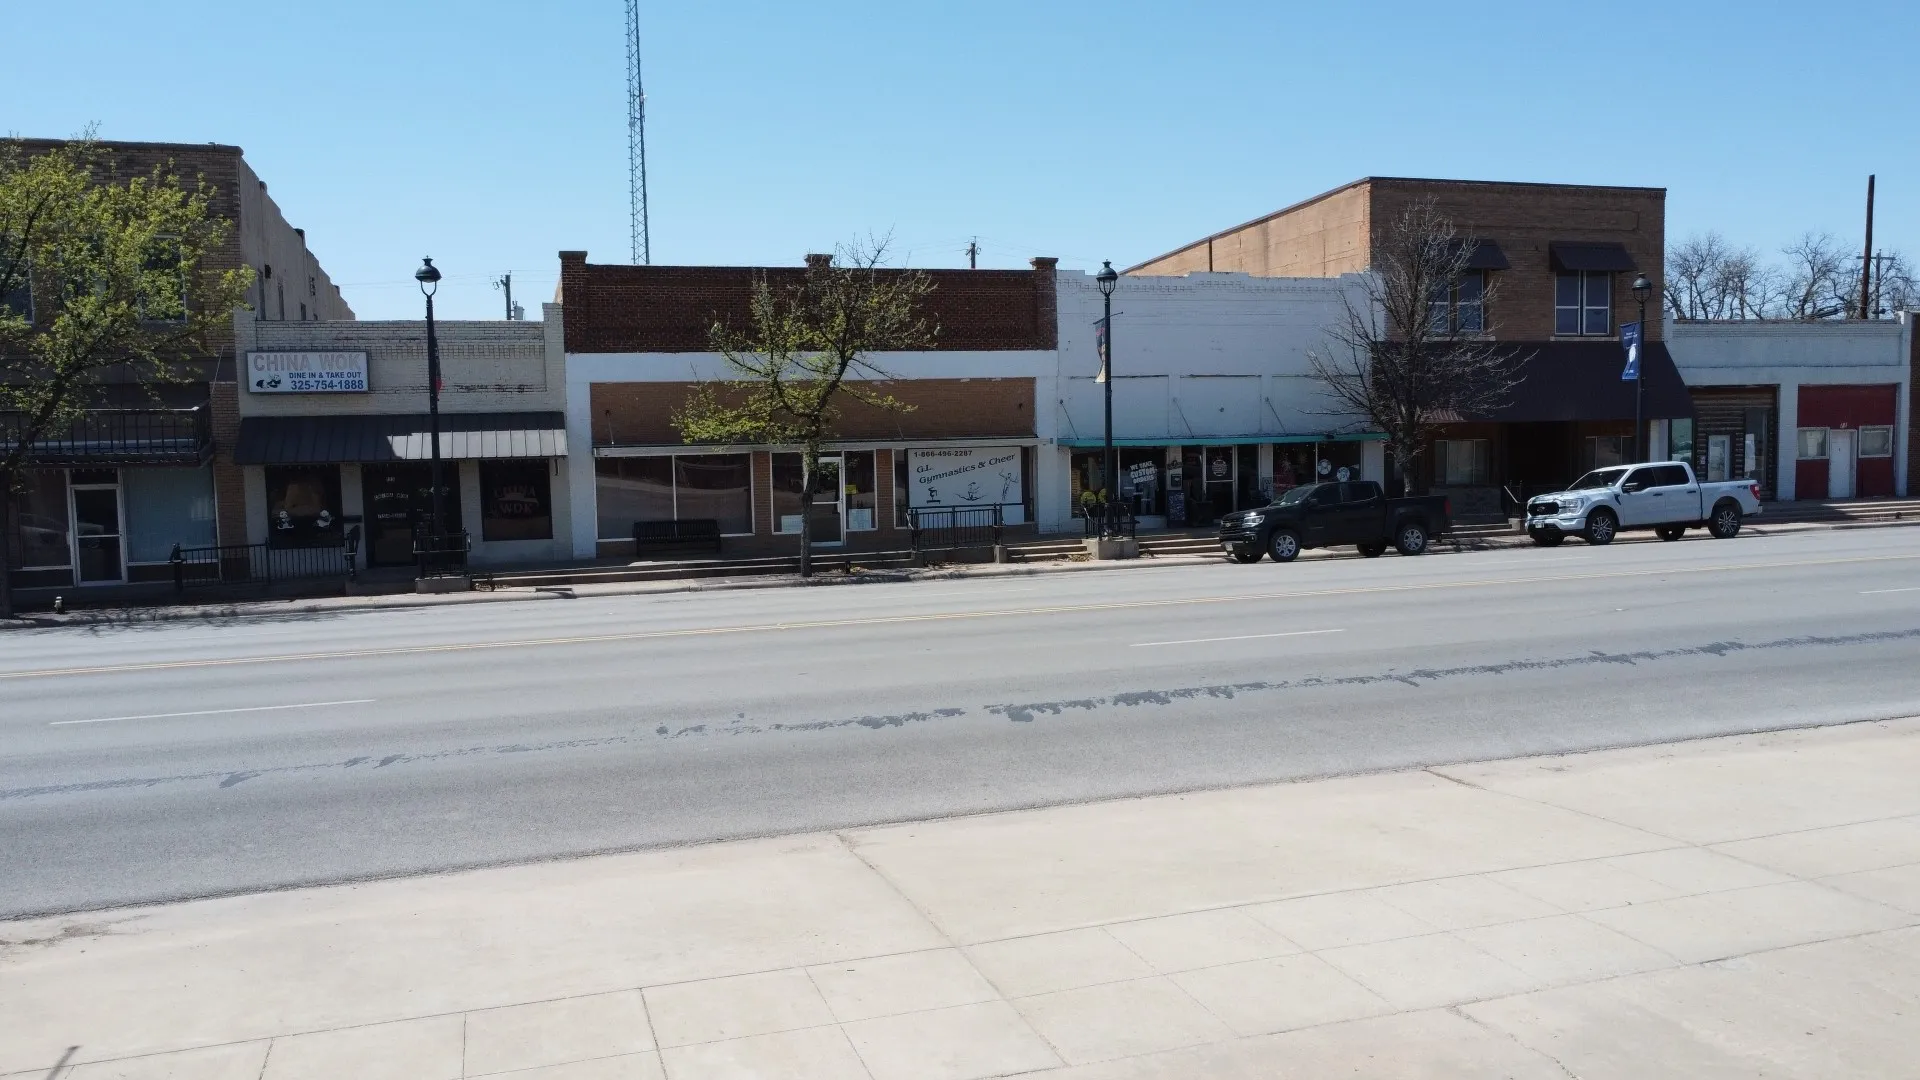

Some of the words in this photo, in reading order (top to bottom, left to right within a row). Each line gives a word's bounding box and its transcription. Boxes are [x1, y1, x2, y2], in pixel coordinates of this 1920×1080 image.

[253, 354, 312, 372] CHINA
[318, 353, 362, 371] WOK
[346, 371, 361, 379] OUT
[290, 379, 364, 390] 325-754-1888
[919, 464, 976, 484] Gymnastics
[977, 460, 986, 469] &
[988, 453, 1016, 466] Cheer
[1130, 467, 1156, 478] CUSTOM
